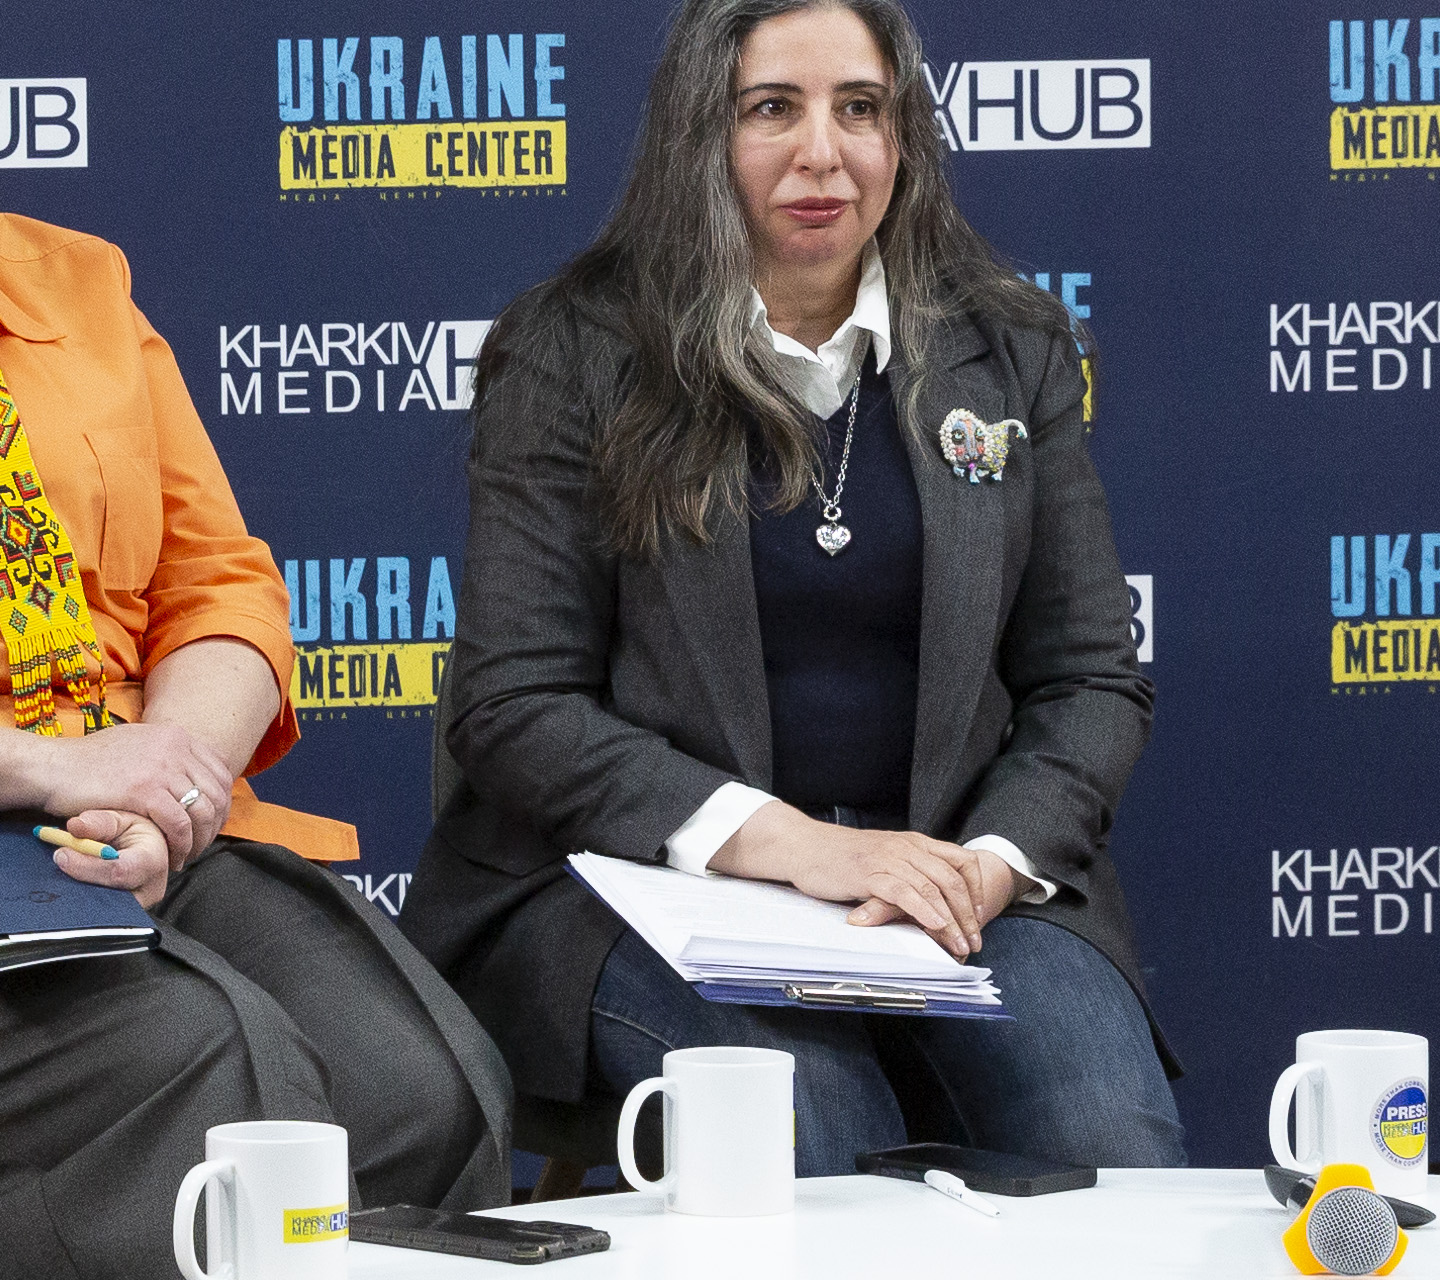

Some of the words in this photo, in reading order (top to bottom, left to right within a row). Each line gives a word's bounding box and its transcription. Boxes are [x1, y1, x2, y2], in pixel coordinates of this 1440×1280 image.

[277, 33, 566, 122] UKRAINE
[969, 67, 1143, 142] HUB
[292, 133, 396, 180] MEDIA
[426, 130, 552, 177] CENTER
[220, 322, 434, 368] KHARKIV
[221, 369, 436, 415] MEDIA
[284, 556, 456, 642] UKRA
[300, 653, 402, 699] MEDIA
[1386, 1103, 1427, 1121] PRESS
